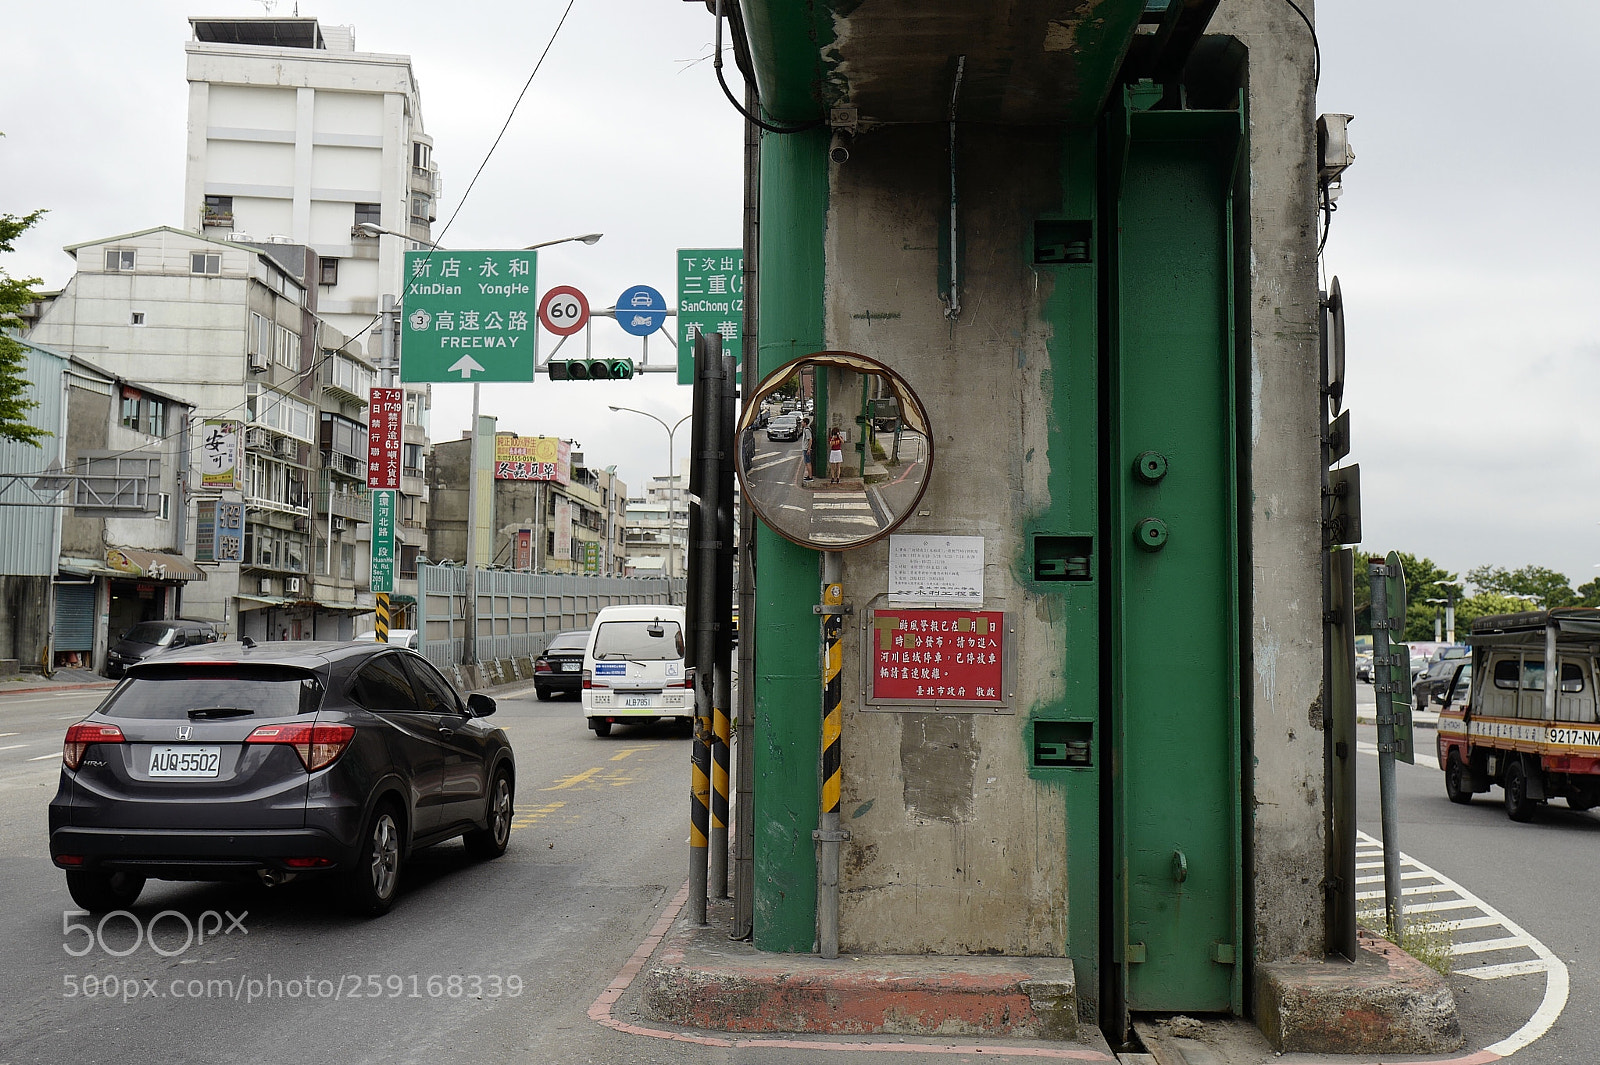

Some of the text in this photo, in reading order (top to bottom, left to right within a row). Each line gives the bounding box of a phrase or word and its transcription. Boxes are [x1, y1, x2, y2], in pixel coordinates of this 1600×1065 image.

[409, 283, 529, 297] XinDian YongHe
[683, 275, 743, 294] 三重(
[551, 302, 578, 318] 60
[681, 299, 729, 315] SanChong
[416, 316, 424, 325] 3
[435, 310, 528, 331] 高速公路
[440, 337, 519, 348] FREEWAY
[385, 391, 400, 400] 7-9
[383, 402, 402, 412] 17-19
[497, 462, 556, 480] 冬蟲夏草
[378, 497, 389, 556] 環河北路一段
